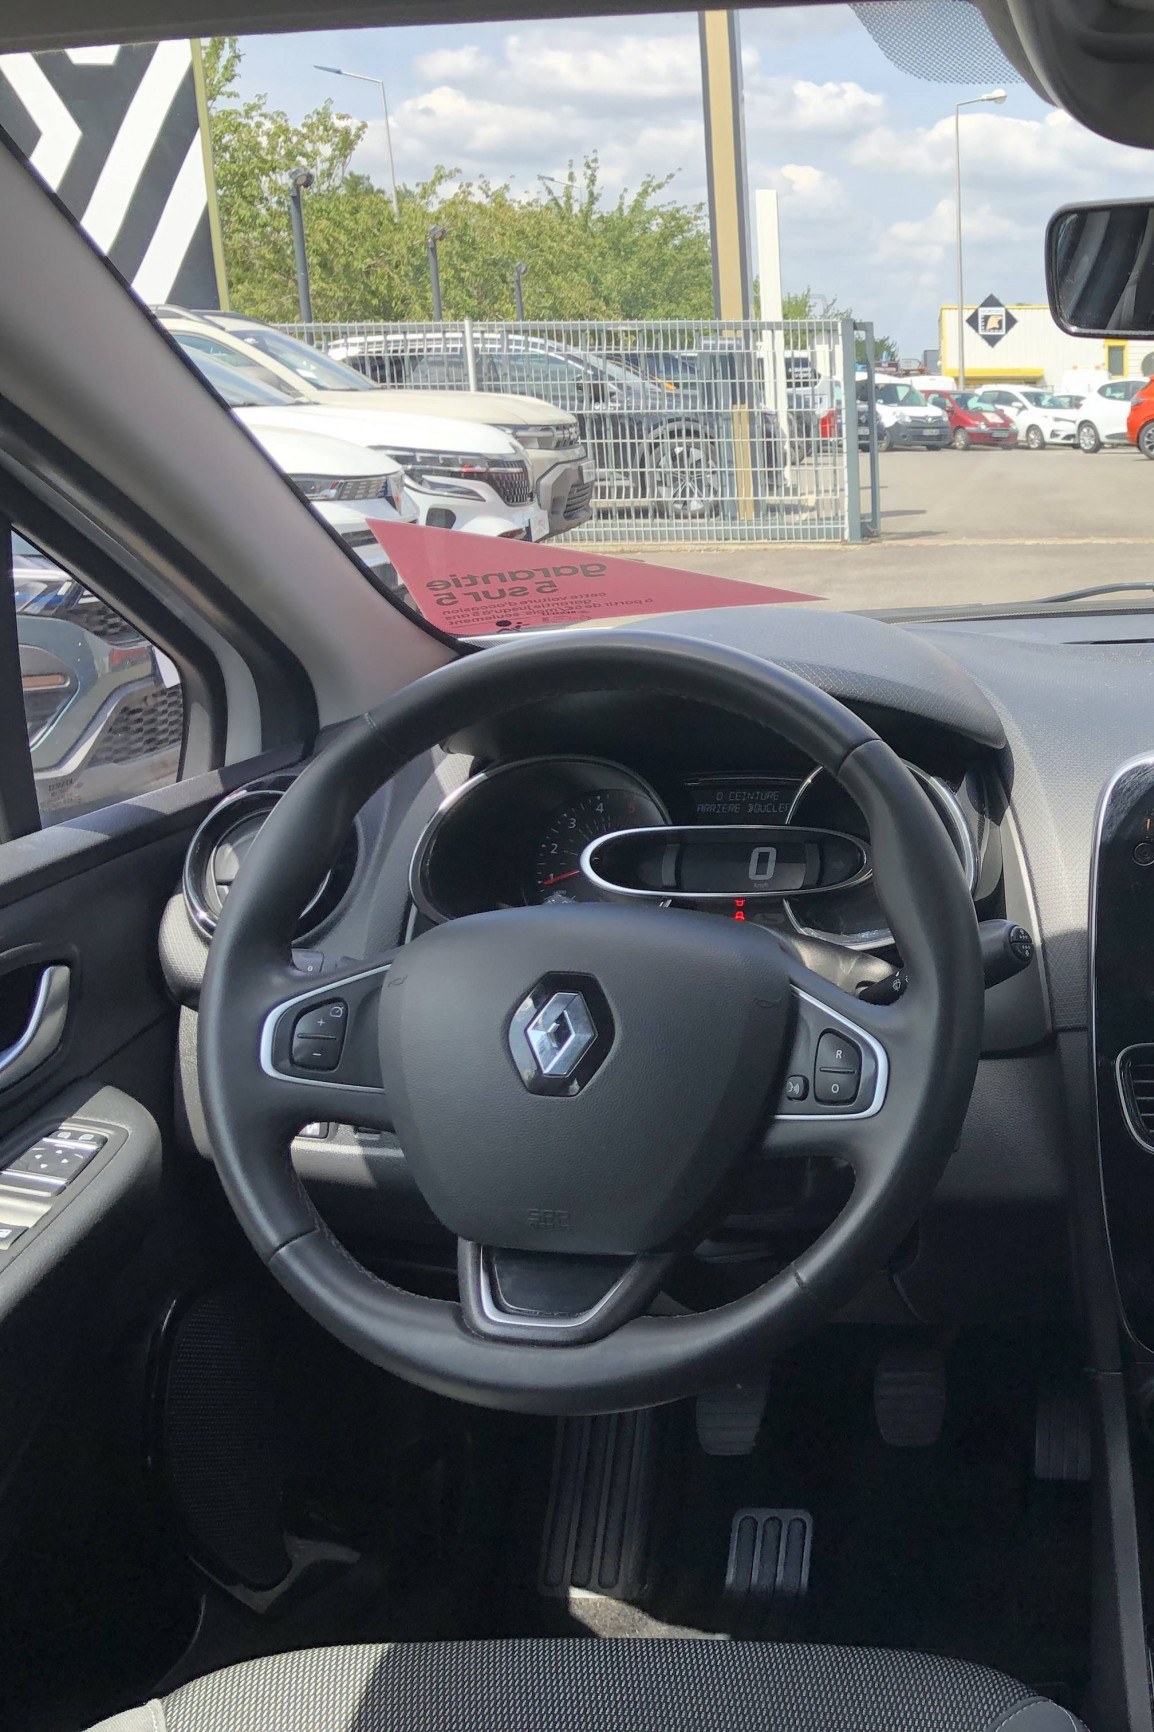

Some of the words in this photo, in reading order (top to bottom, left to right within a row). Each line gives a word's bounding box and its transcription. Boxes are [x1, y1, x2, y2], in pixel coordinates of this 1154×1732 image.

[729, 791, 780, 801] CEINTURE
[596, 802, 604, 813] 4
[628, 802, 636, 813] 5
[697, 803, 740, 813] ARRIERE
[568, 818, 577, 829] 3
[550, 843, 558, 854] 2
[748, 846, 777, 880] 0
[835, 1050, 842, 1059] R
